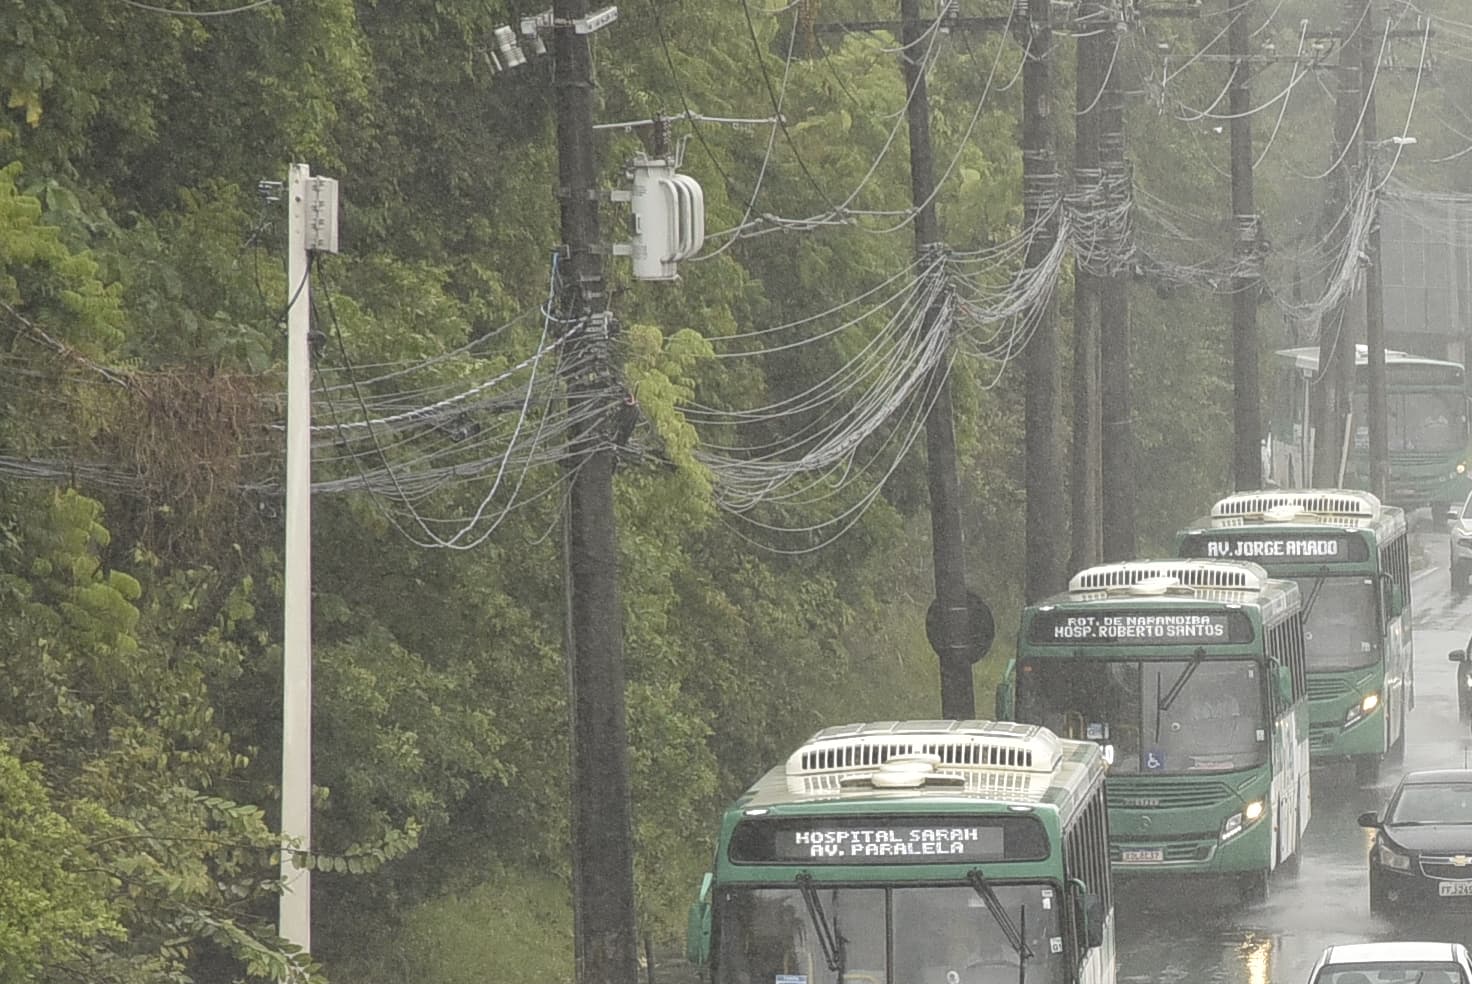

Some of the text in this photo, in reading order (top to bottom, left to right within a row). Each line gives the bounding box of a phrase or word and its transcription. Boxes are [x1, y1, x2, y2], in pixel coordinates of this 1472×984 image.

[1235, 541, 1284, 556] JORGE
[1286, 540, 1337, 556] AMADO
[1104, 617, 1122, 625] DE
[1126, 616, 1210, 625] NARANDIBA
[1167, 624, 1224, 637] SANTOS
[796, 828, 978, 844] HOSPITAL SARAH
[810, 841, 964, 857] AV. PARALELA
